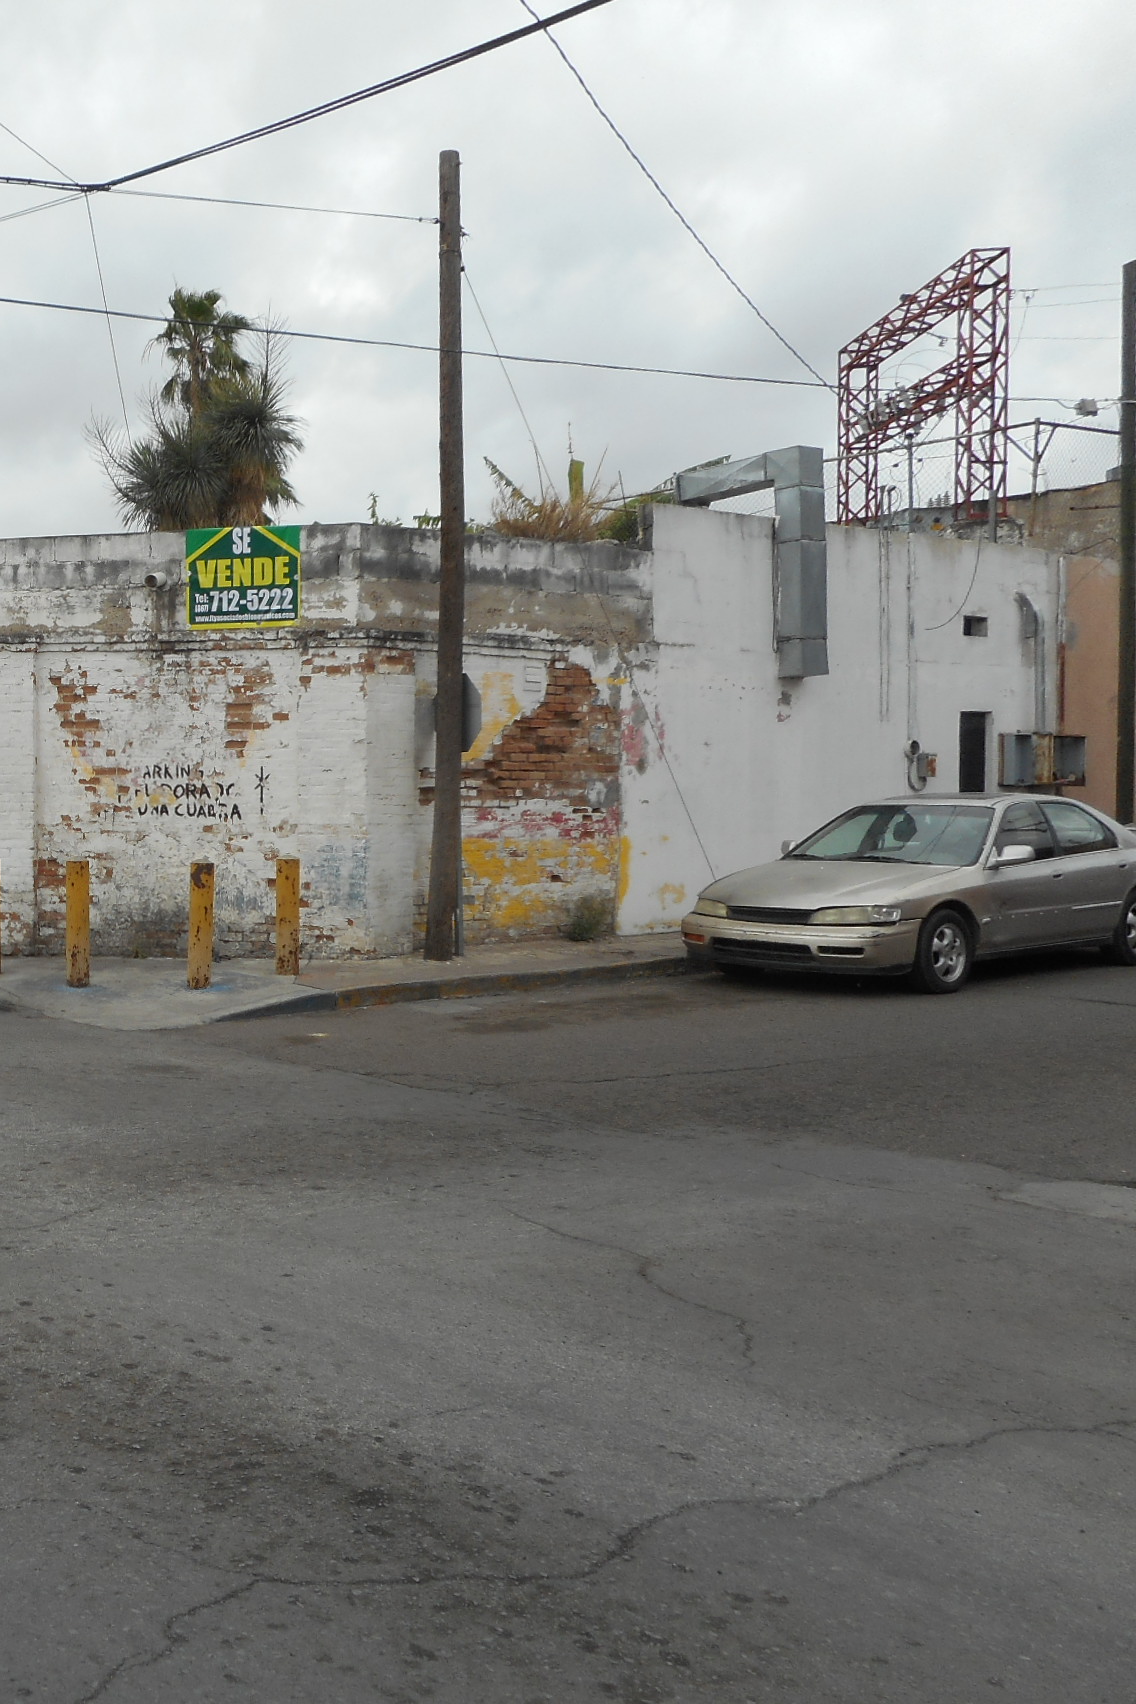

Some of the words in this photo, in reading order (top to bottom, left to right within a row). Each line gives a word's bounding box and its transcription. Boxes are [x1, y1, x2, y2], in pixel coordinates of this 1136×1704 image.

[232, 527, 252, 555] SE
[195, 556, 290, 589] VENDE
[194, 593, 209, 603] Tel:
[209, 588, 294, 612] 712-5222
[137, 803, 169, 816] UNA
